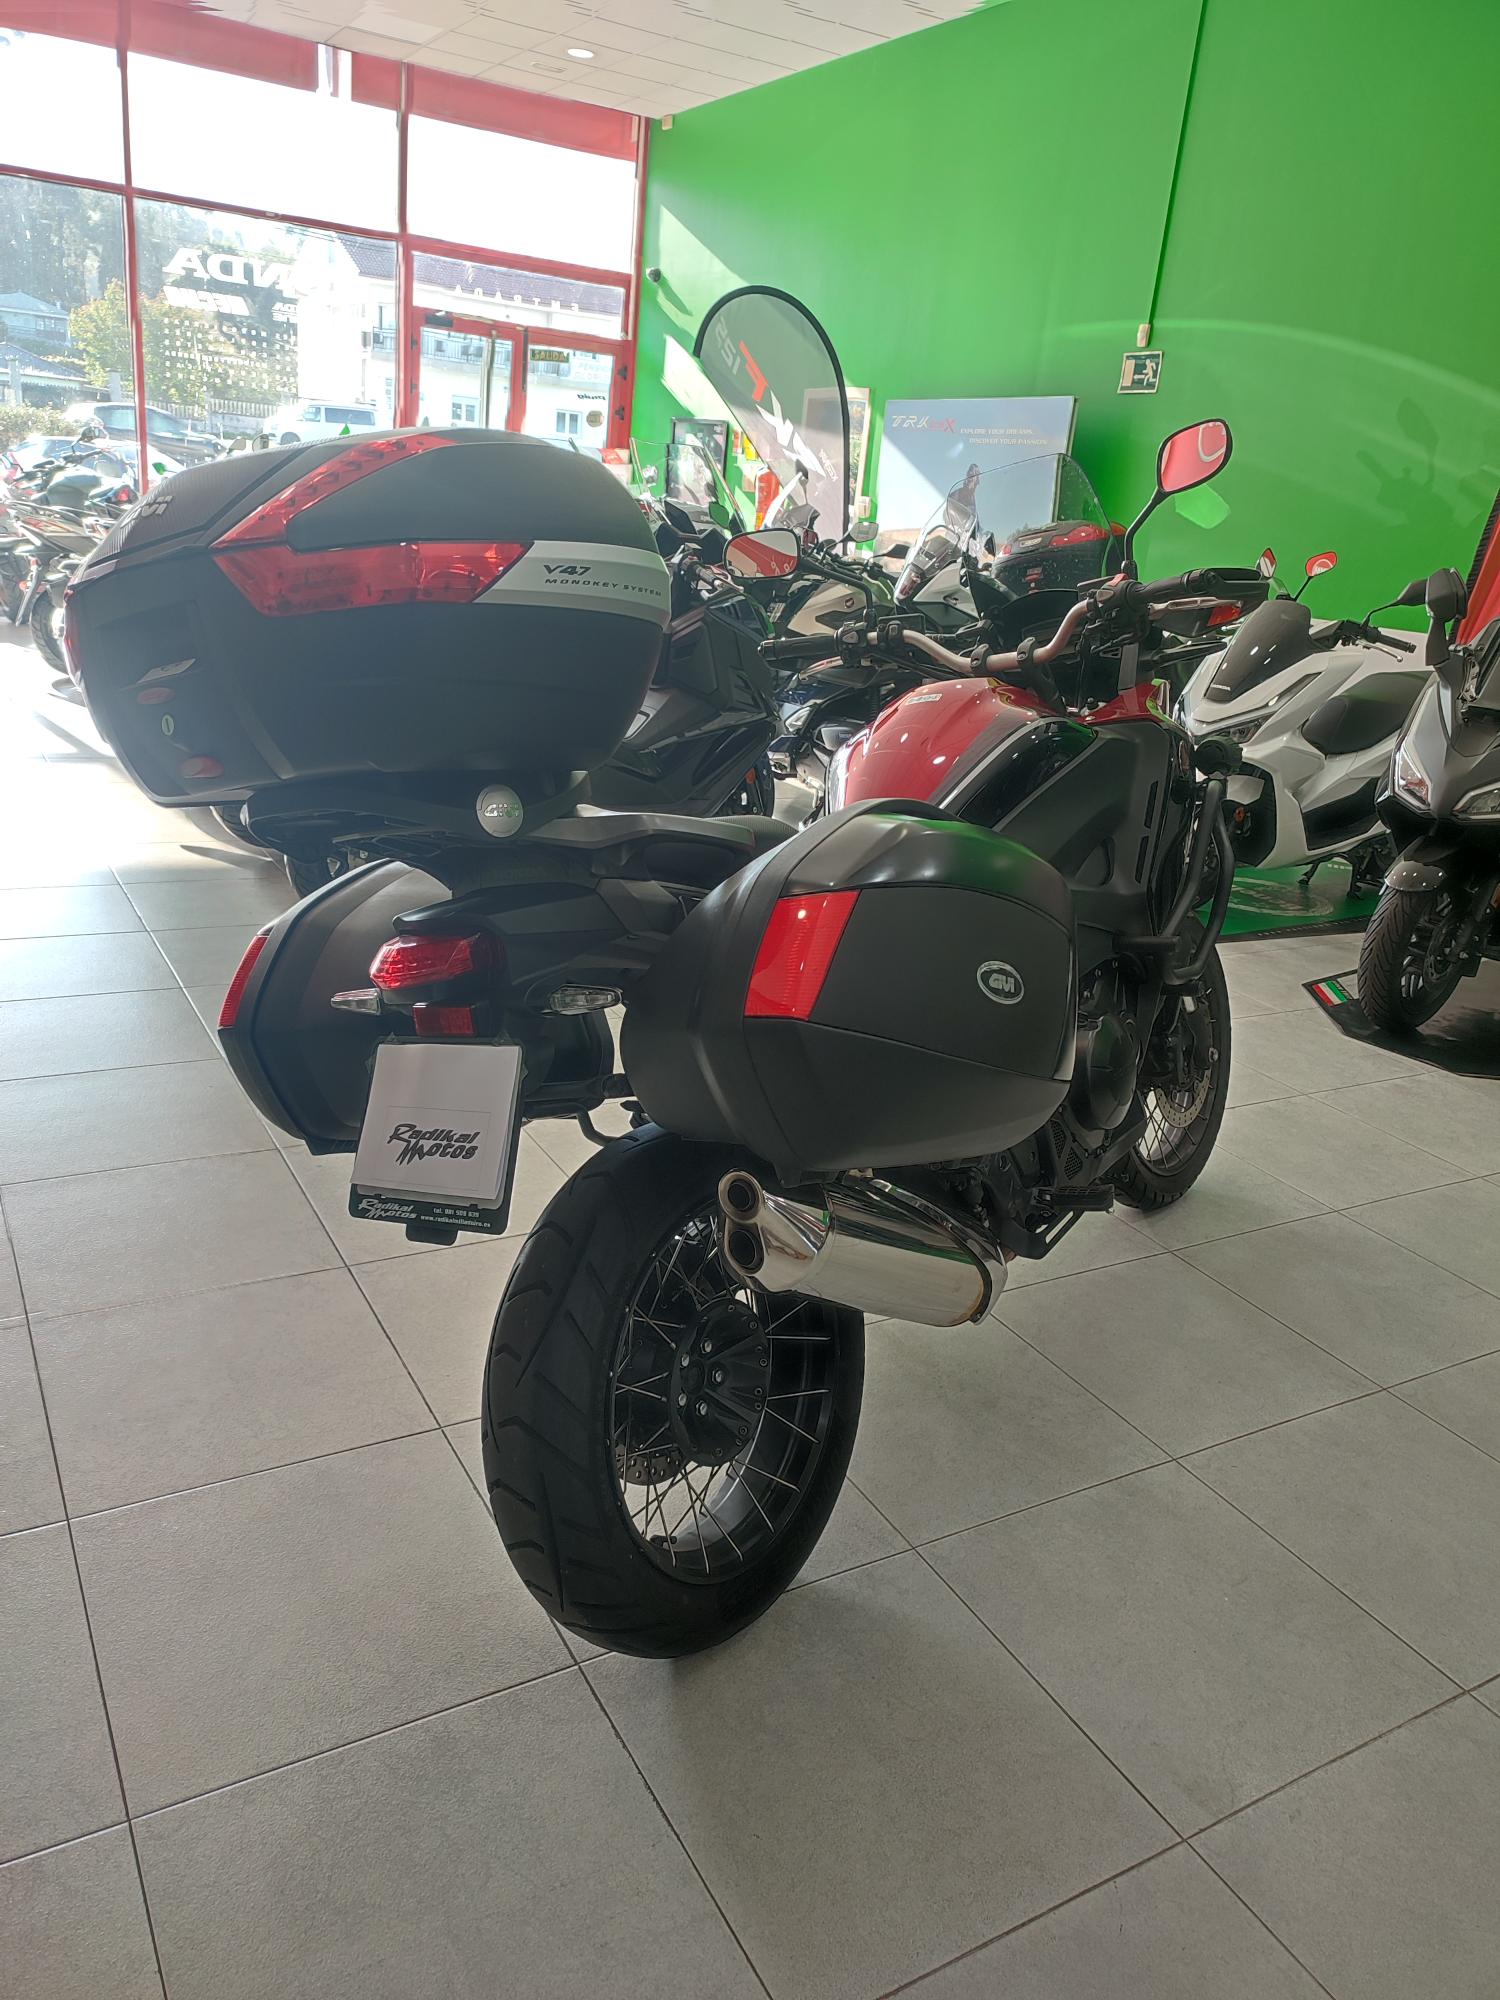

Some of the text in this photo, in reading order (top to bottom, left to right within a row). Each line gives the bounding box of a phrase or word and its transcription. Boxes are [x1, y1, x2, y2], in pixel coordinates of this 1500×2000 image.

[534, 350, 565, 361] SALIDA
[544, 564, 592, 576] V47
[544, 578, 662, 597] MONOKEY SYSTEM
[387, 1123, 481, 1144] Radikal
[395, 1140, 479, 1166] Motos
[358, 1198, 415, 1212] Radikal
[365, 1208, 418, 1219] Motos
